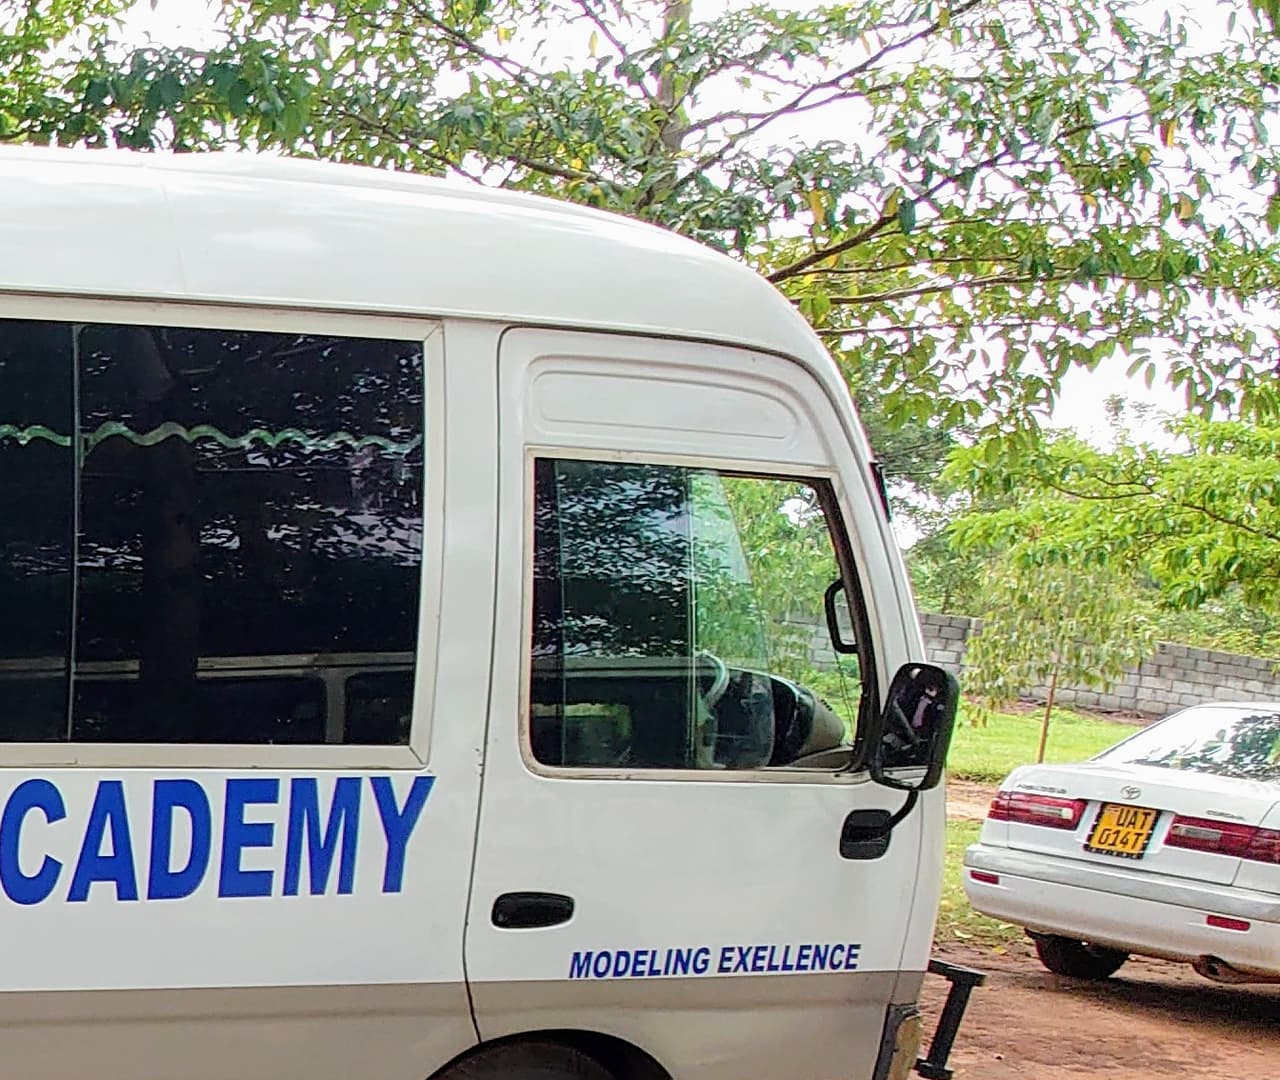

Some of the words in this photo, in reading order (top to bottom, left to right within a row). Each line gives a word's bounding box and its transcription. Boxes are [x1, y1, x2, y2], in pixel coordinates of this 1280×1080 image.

[1116, 808, 1151, 829] UAT
[568, 947, 710, 979] MODELING
[716, 943, 862, 974] EXELLENCE
